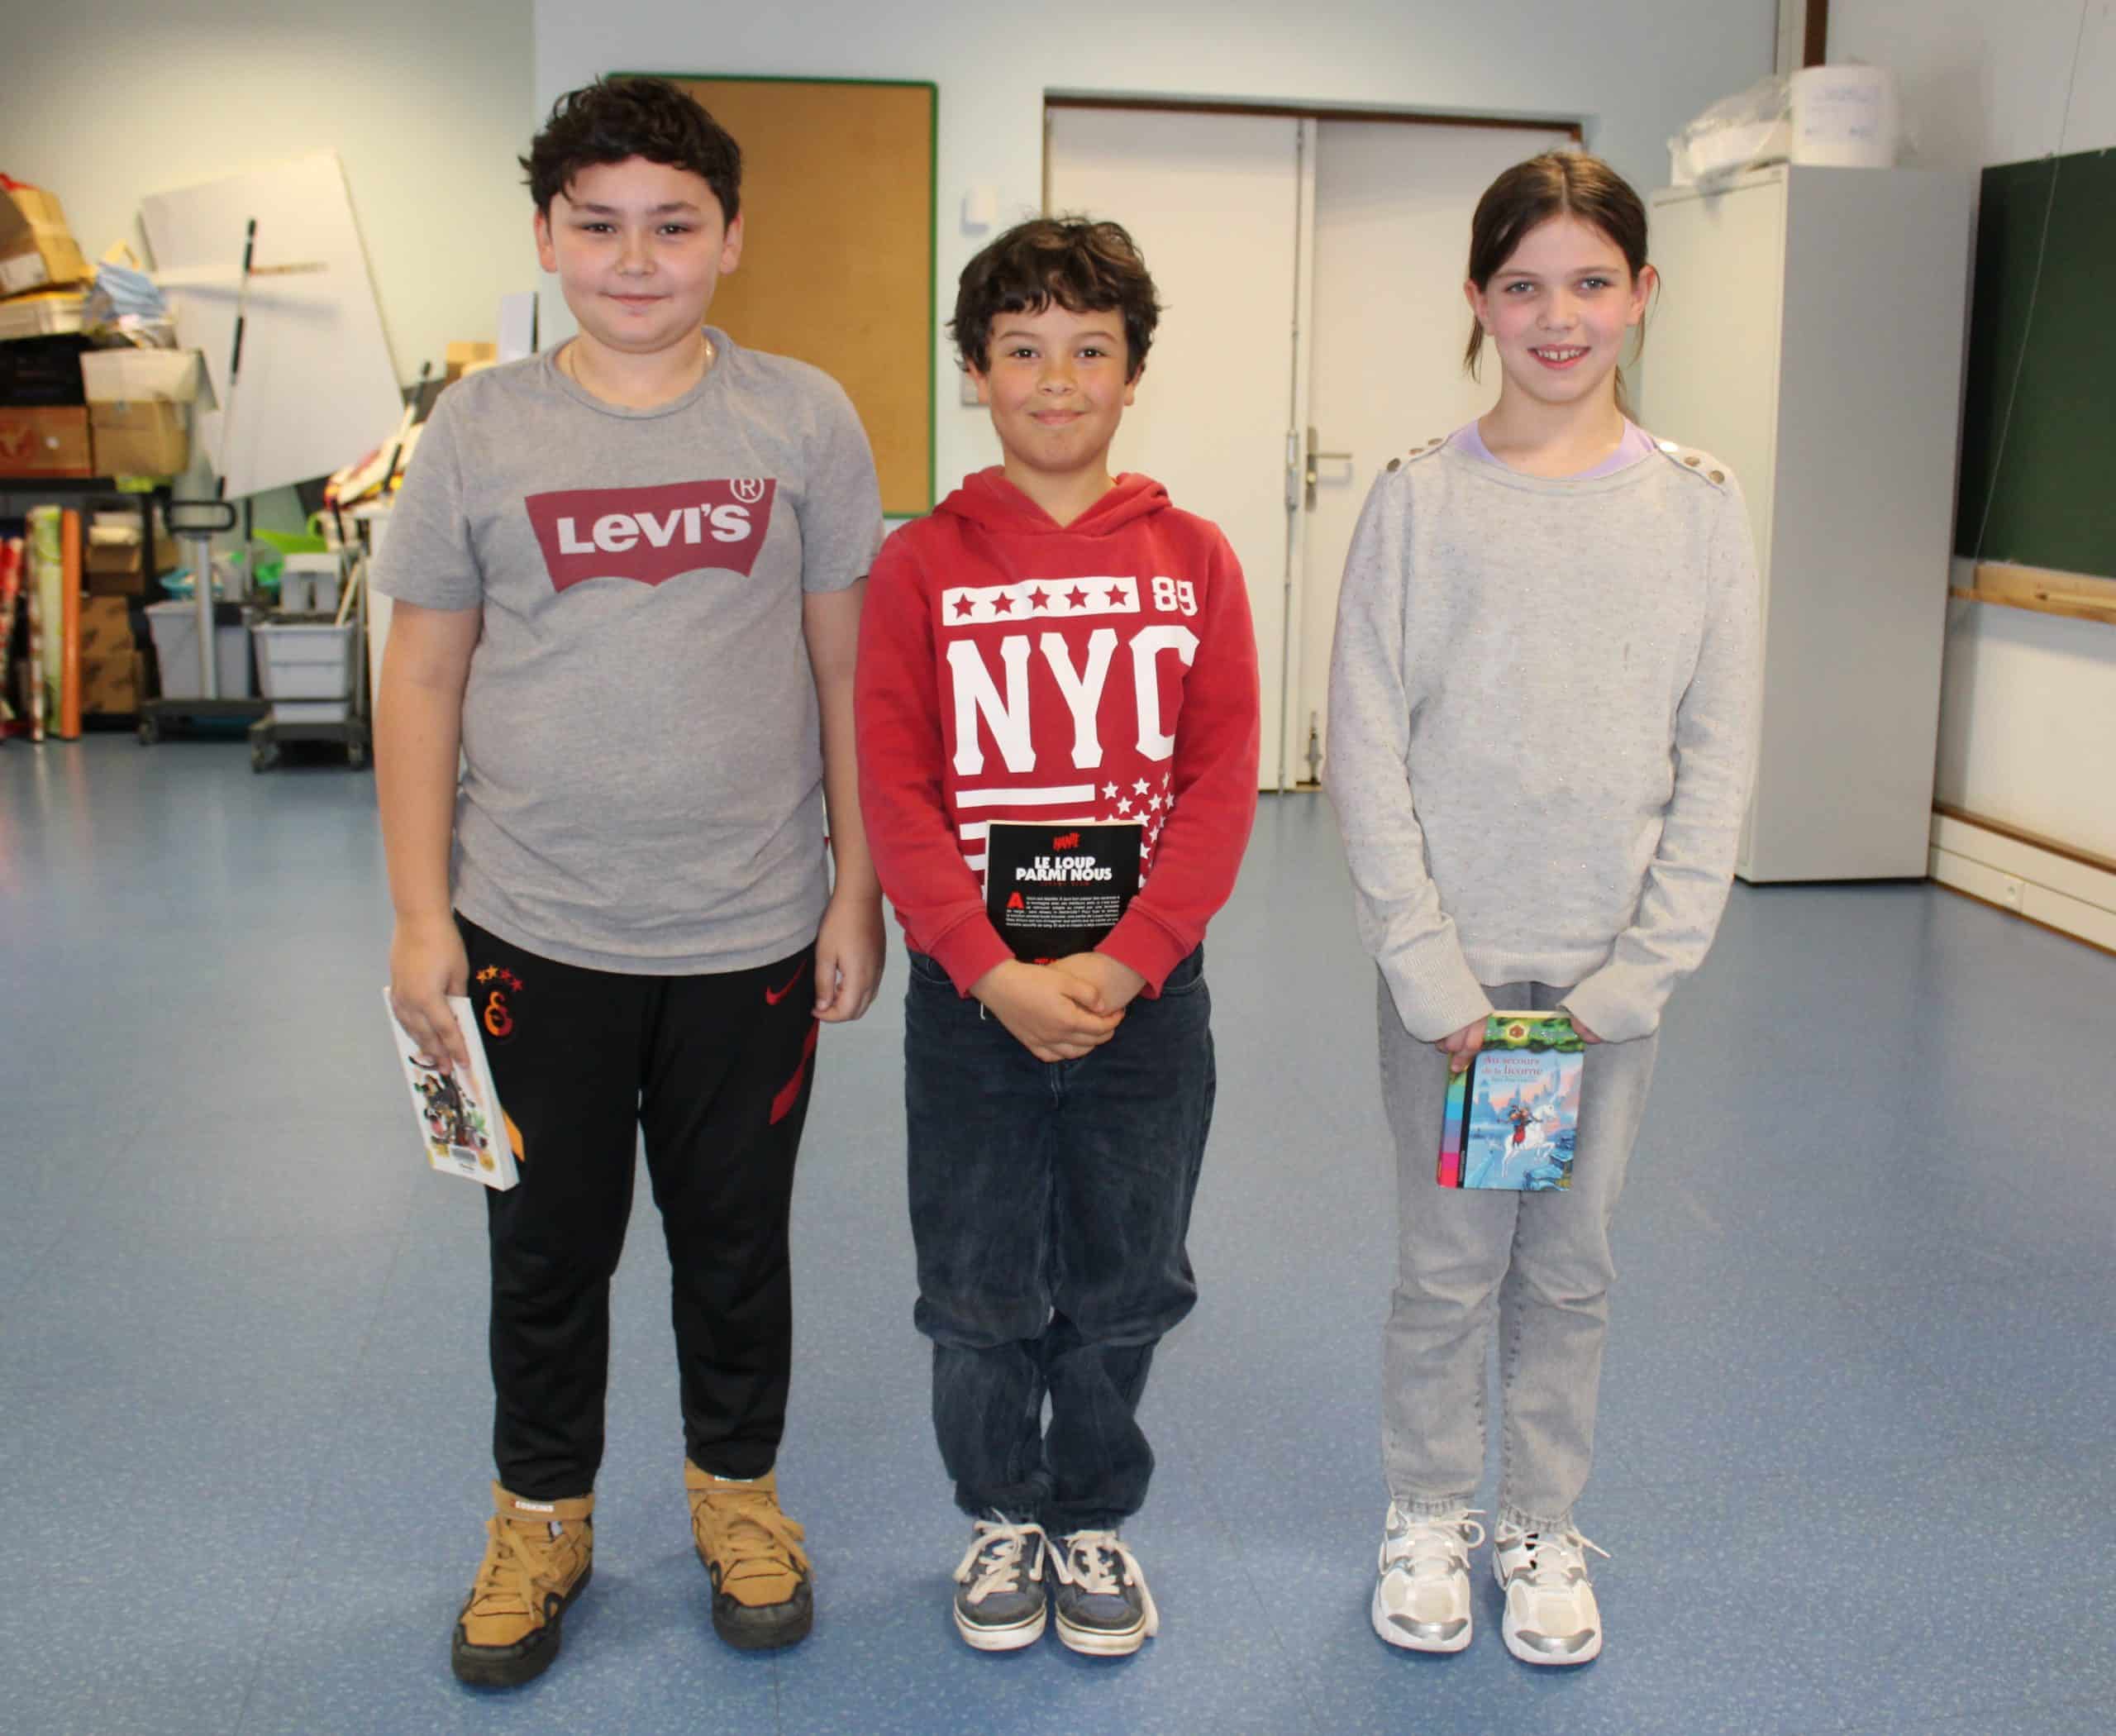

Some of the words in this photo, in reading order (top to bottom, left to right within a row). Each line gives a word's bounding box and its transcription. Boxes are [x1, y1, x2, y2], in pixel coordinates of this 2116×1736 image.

[1151, 576, 1198, 616] 89
[946, 625, 1200, 775] NYC
[1016, 868, 1067, 881] PARMI
[1070, 868, 1113, 881] NOUS
[1034, 856, 1051, 870] LE
[1055, 856, 1096, 870] LOUP
